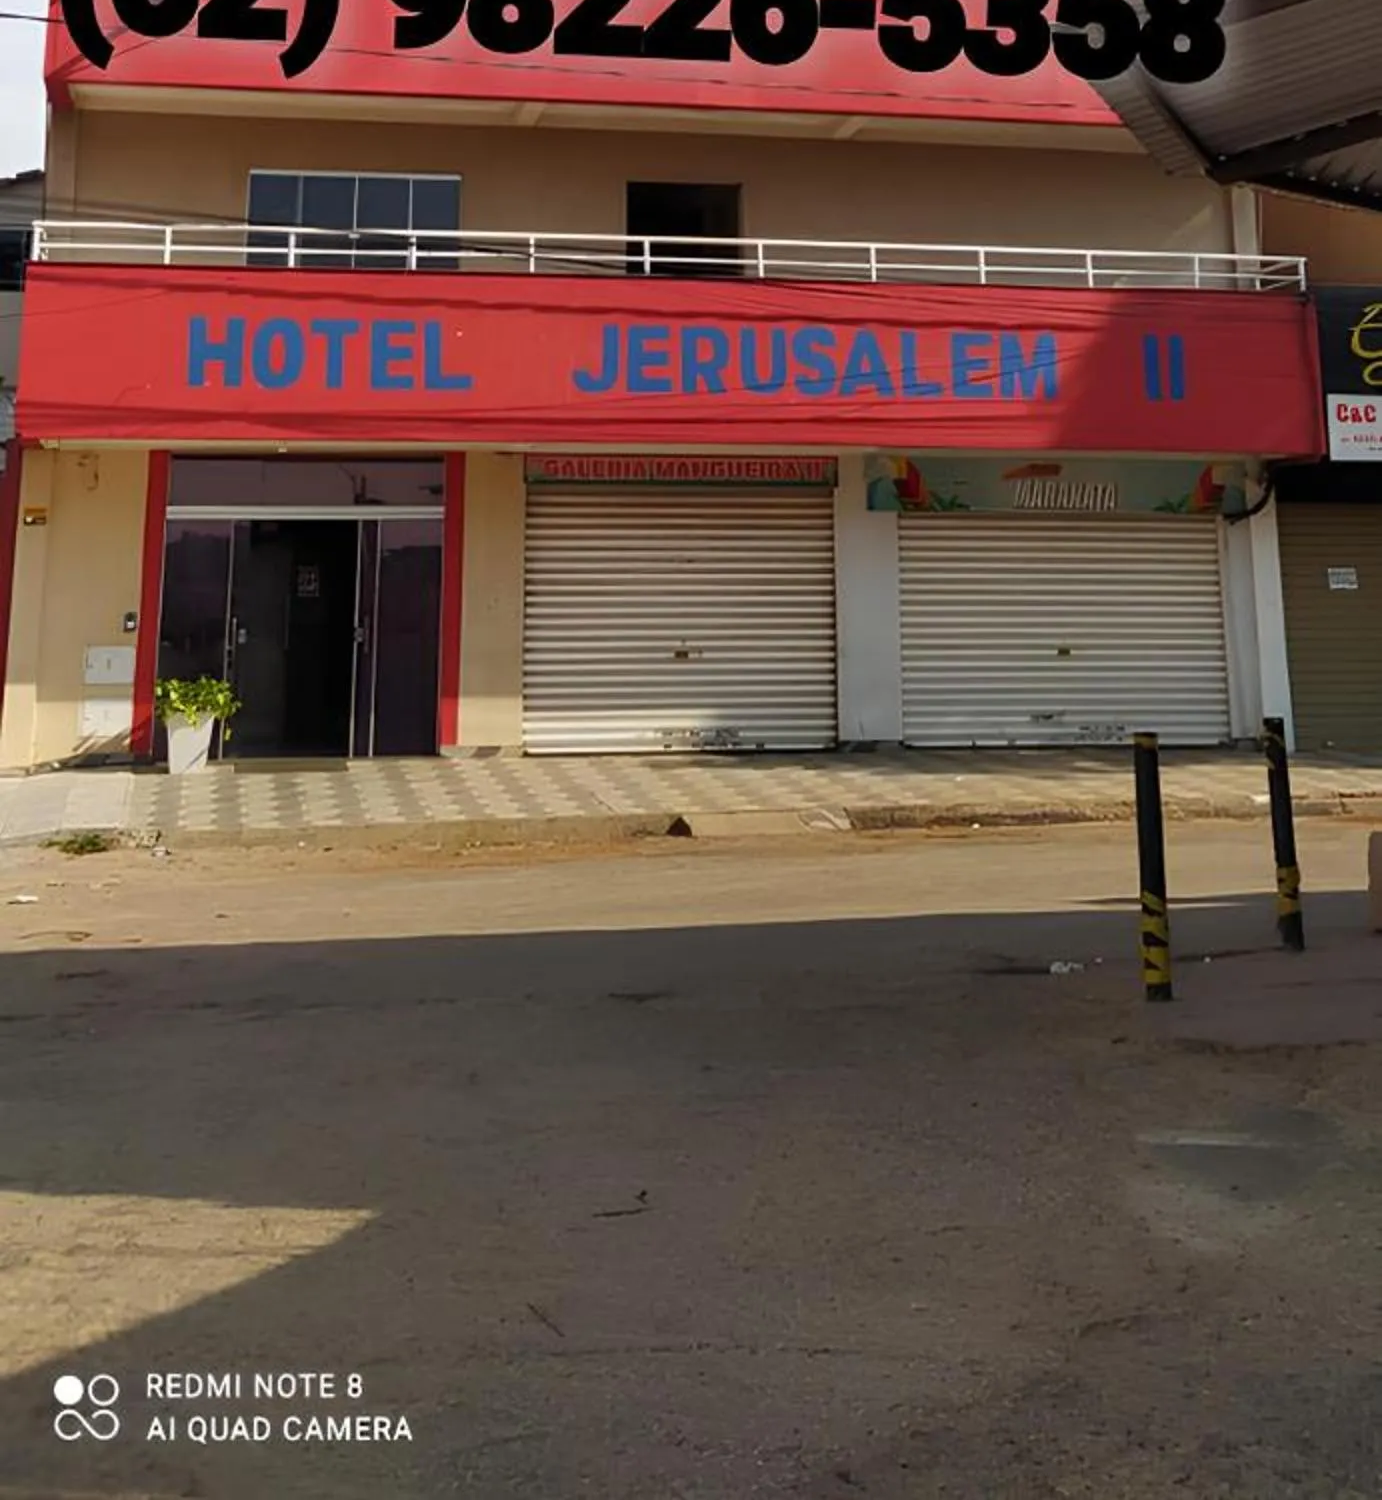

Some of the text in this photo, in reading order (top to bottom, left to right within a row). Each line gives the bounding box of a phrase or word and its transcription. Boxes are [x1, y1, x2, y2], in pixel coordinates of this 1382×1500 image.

[187, 316, 1185, 402] HOTEL JERUSALEM II
